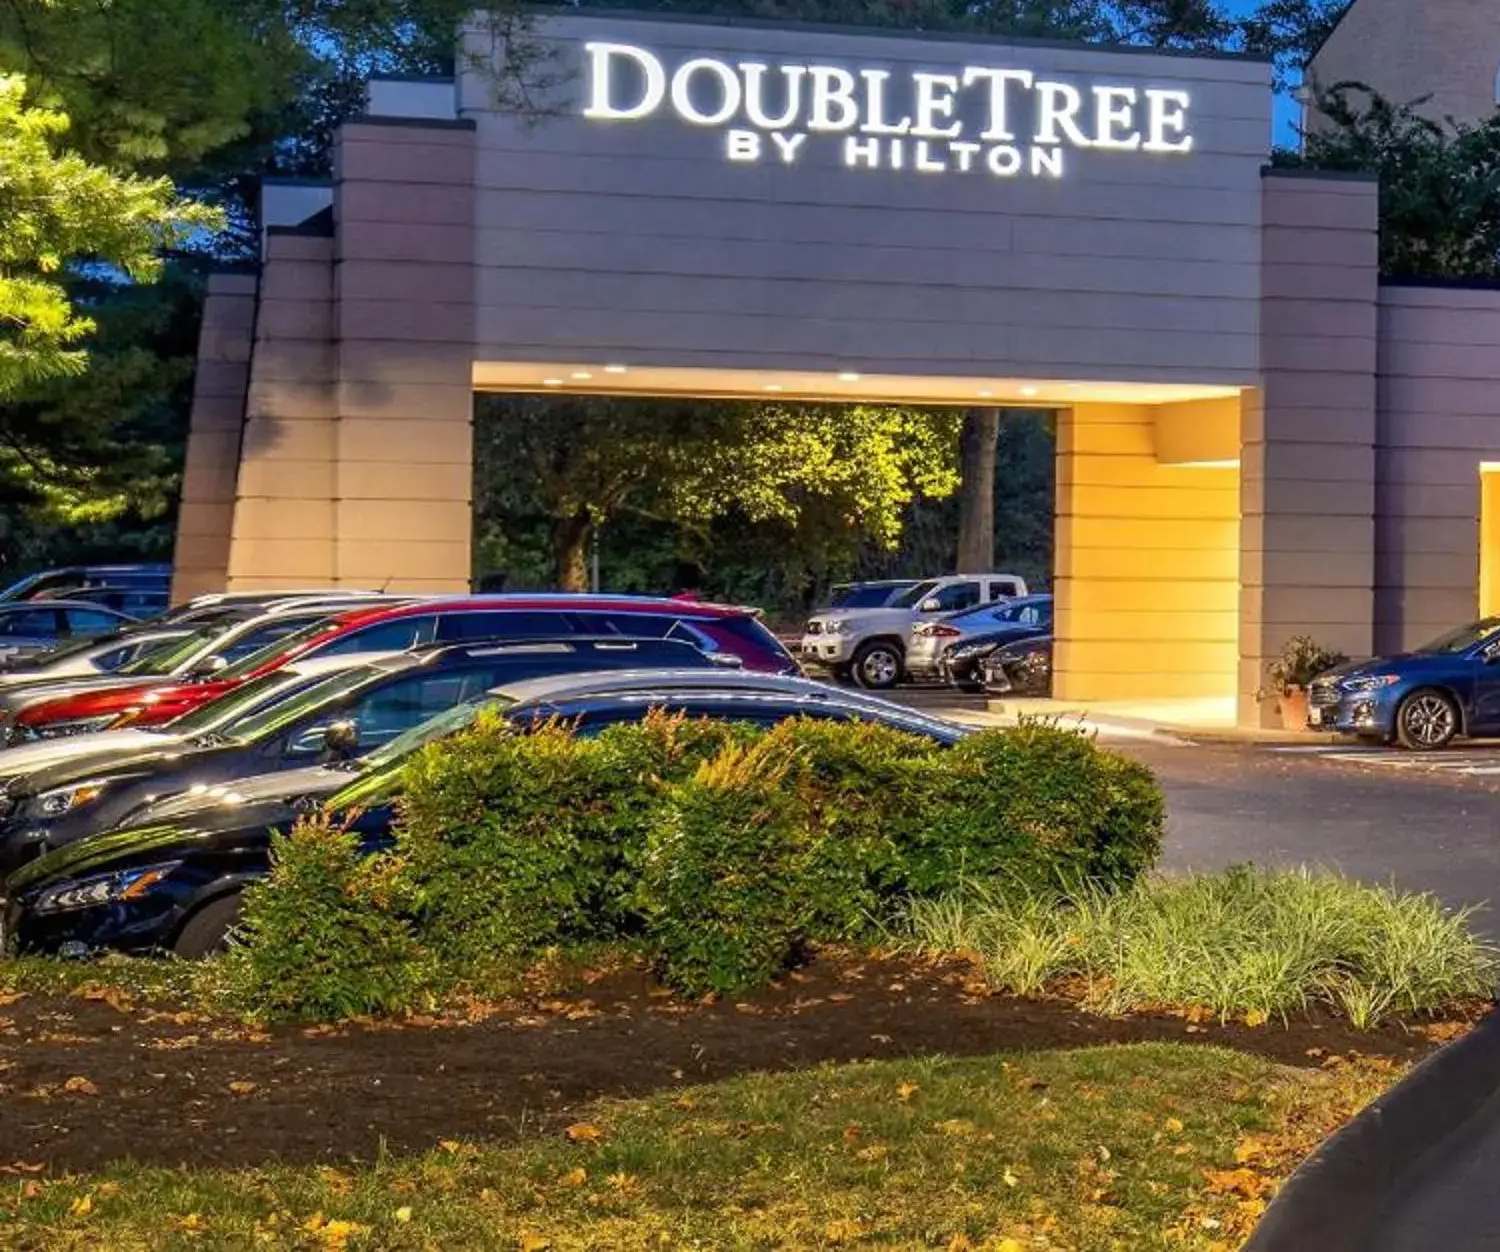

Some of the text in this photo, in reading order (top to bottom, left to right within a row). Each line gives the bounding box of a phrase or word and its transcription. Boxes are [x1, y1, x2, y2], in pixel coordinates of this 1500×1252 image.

[582, 41, 1194, 152] DOUBLETREE
[726, 129, 1064, 178] BY HILTON
